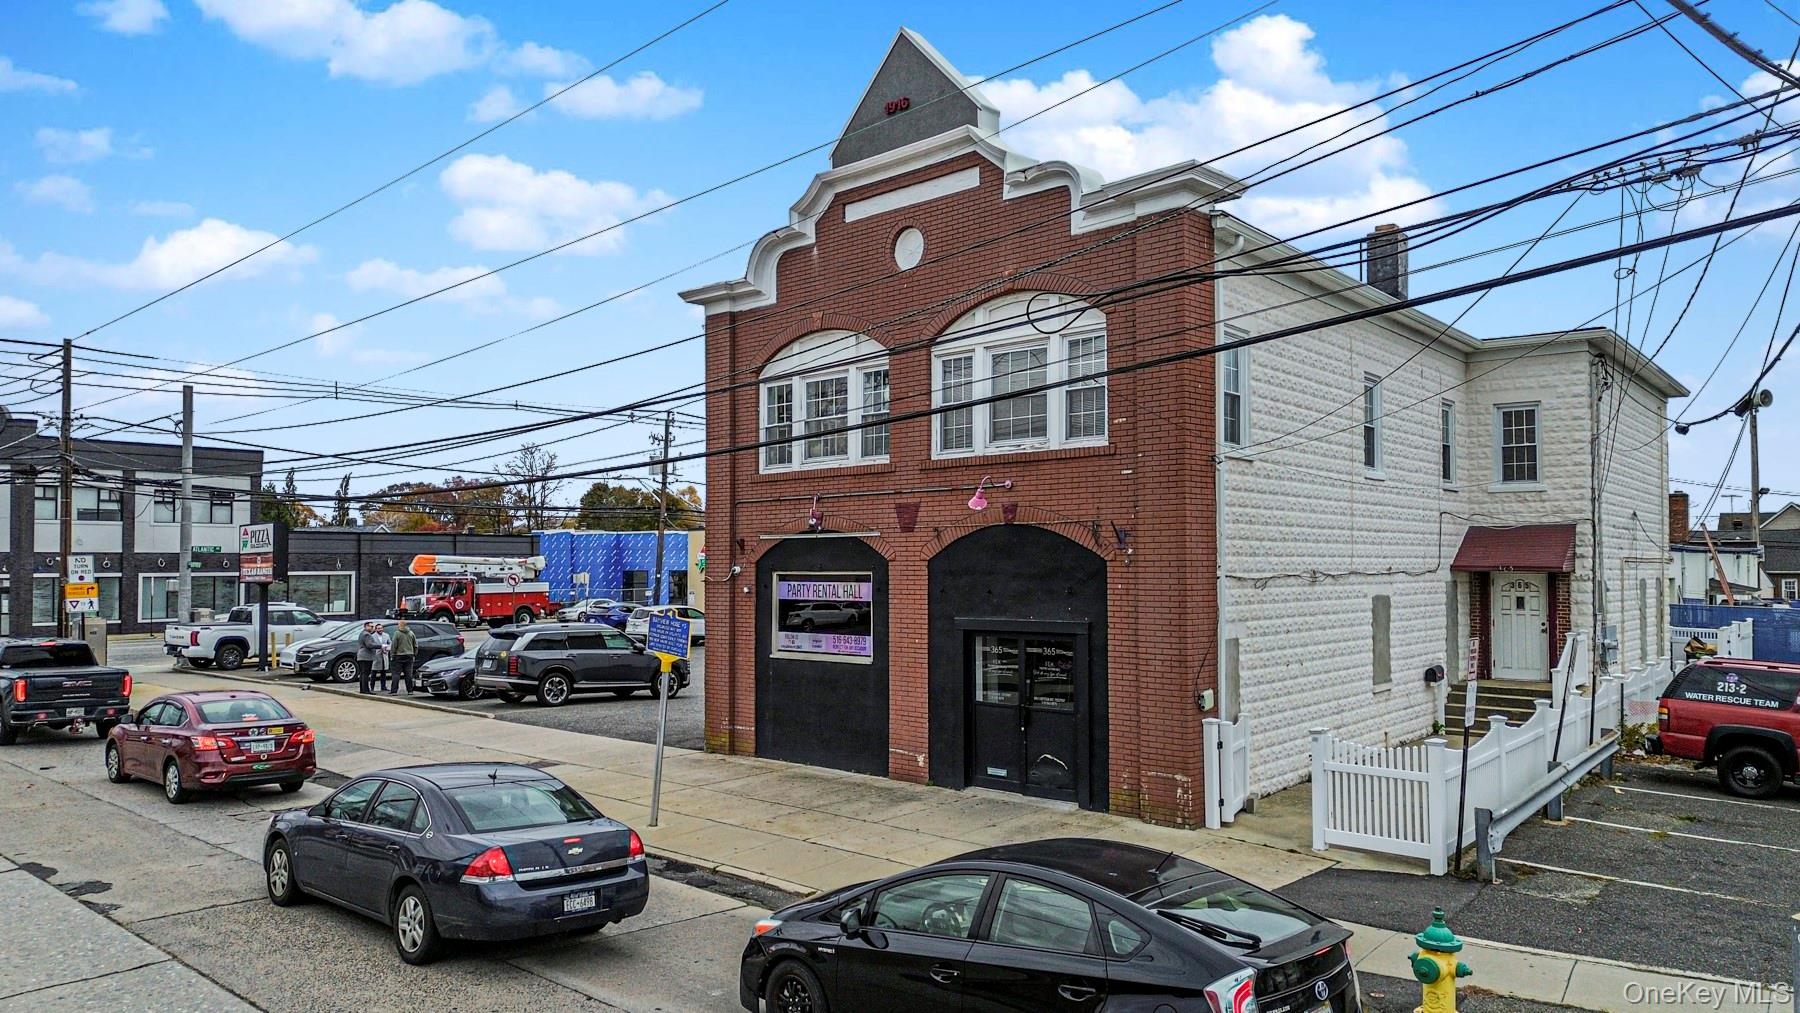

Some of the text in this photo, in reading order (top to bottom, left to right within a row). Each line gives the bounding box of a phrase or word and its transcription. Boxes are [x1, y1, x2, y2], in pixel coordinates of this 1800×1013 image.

[884, 96, 910, 115] 1916
[250, 528, 271, 545] PIZZA
[787, 583, 863, 599] PARTY RENTAL HALL
[1510, 581, 1530, 589] 365
[832, 635, 866, 646] 516-643-8979
[990, 645, 1003, 654] 365
[1042, 647, 1056, 656] 365
[1717, 681, 1747, 694] 213-2
[1685, 691, 1779, 708] WATER RESCUE TEAM
